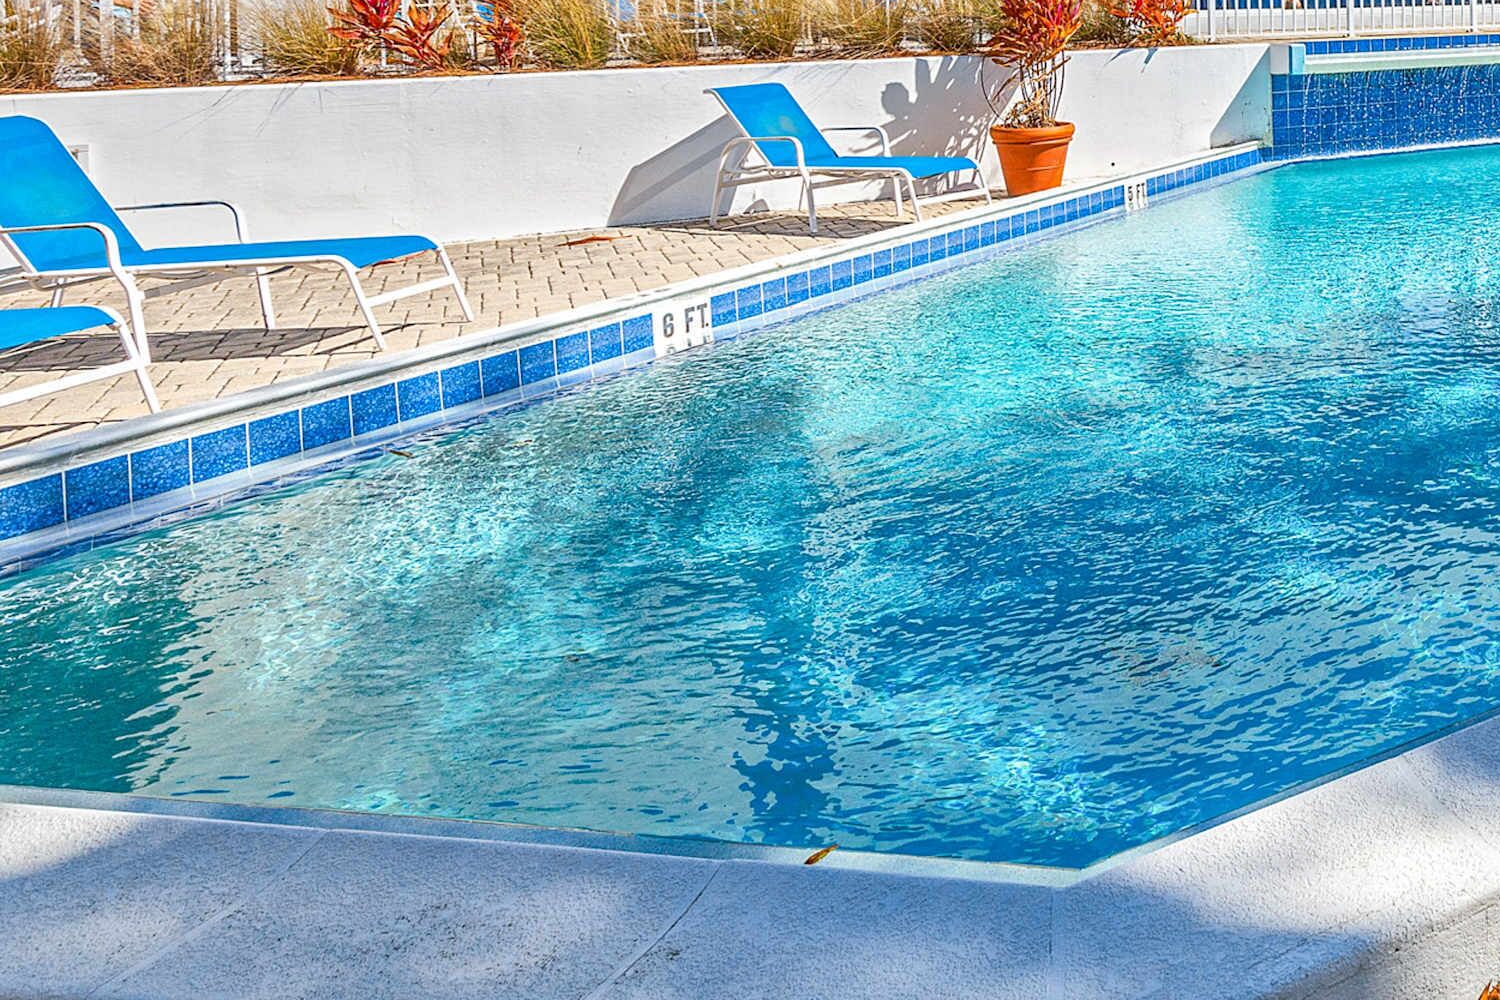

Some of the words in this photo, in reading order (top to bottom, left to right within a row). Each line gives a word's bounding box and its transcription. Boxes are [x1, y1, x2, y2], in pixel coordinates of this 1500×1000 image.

[1128, 185, 1133, 201] 5
[1136, 182, 1145, 200] FT
[663, 312, 674, 338] 6
